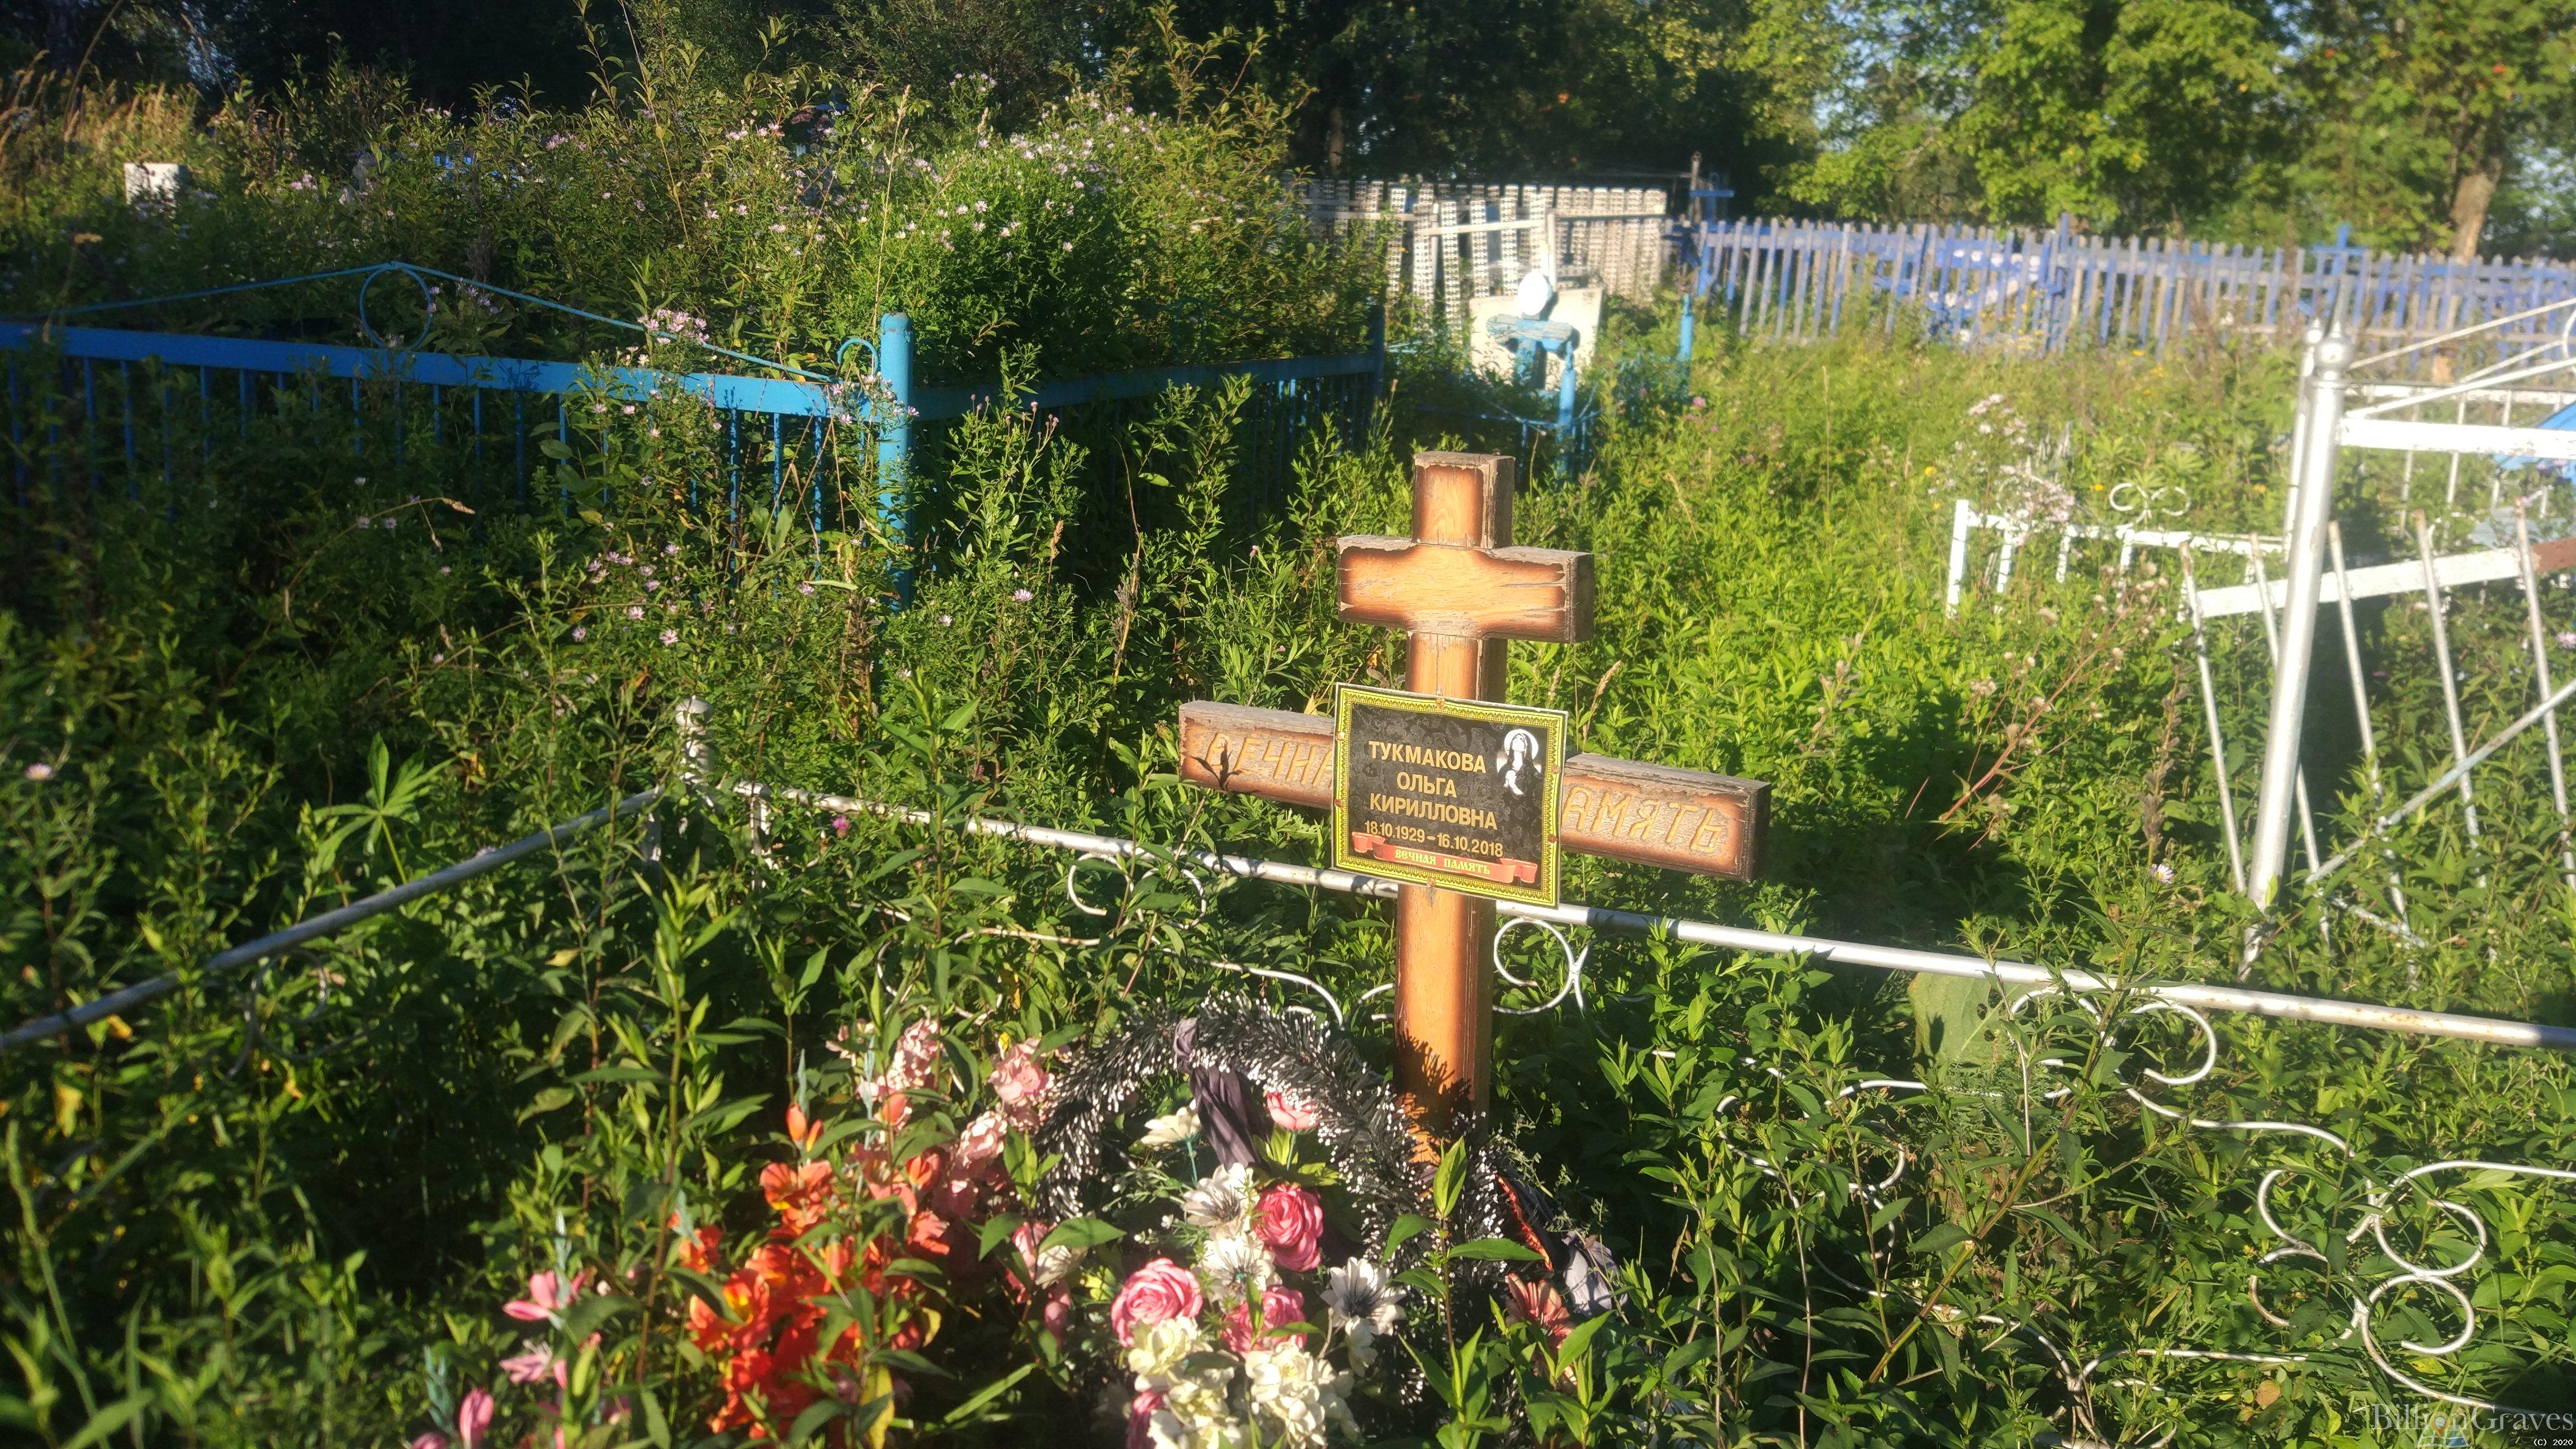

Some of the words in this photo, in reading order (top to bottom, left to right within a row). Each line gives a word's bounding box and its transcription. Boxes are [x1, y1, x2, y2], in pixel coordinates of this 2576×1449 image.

[1368, 740, 1487, 774] ТУКМАКОВА
[1396, 771, 1457, 798] ОЛЬГА
[1370, 793, 1498, 830] КИРИЛЛОВНА
[1561, 785, 1722, 854] АМЯТЬ
[1395, 849, 1437, 866] ВЕЧНАЯ
[1443, 858, 1490, 875] ПАМЯТЬ
